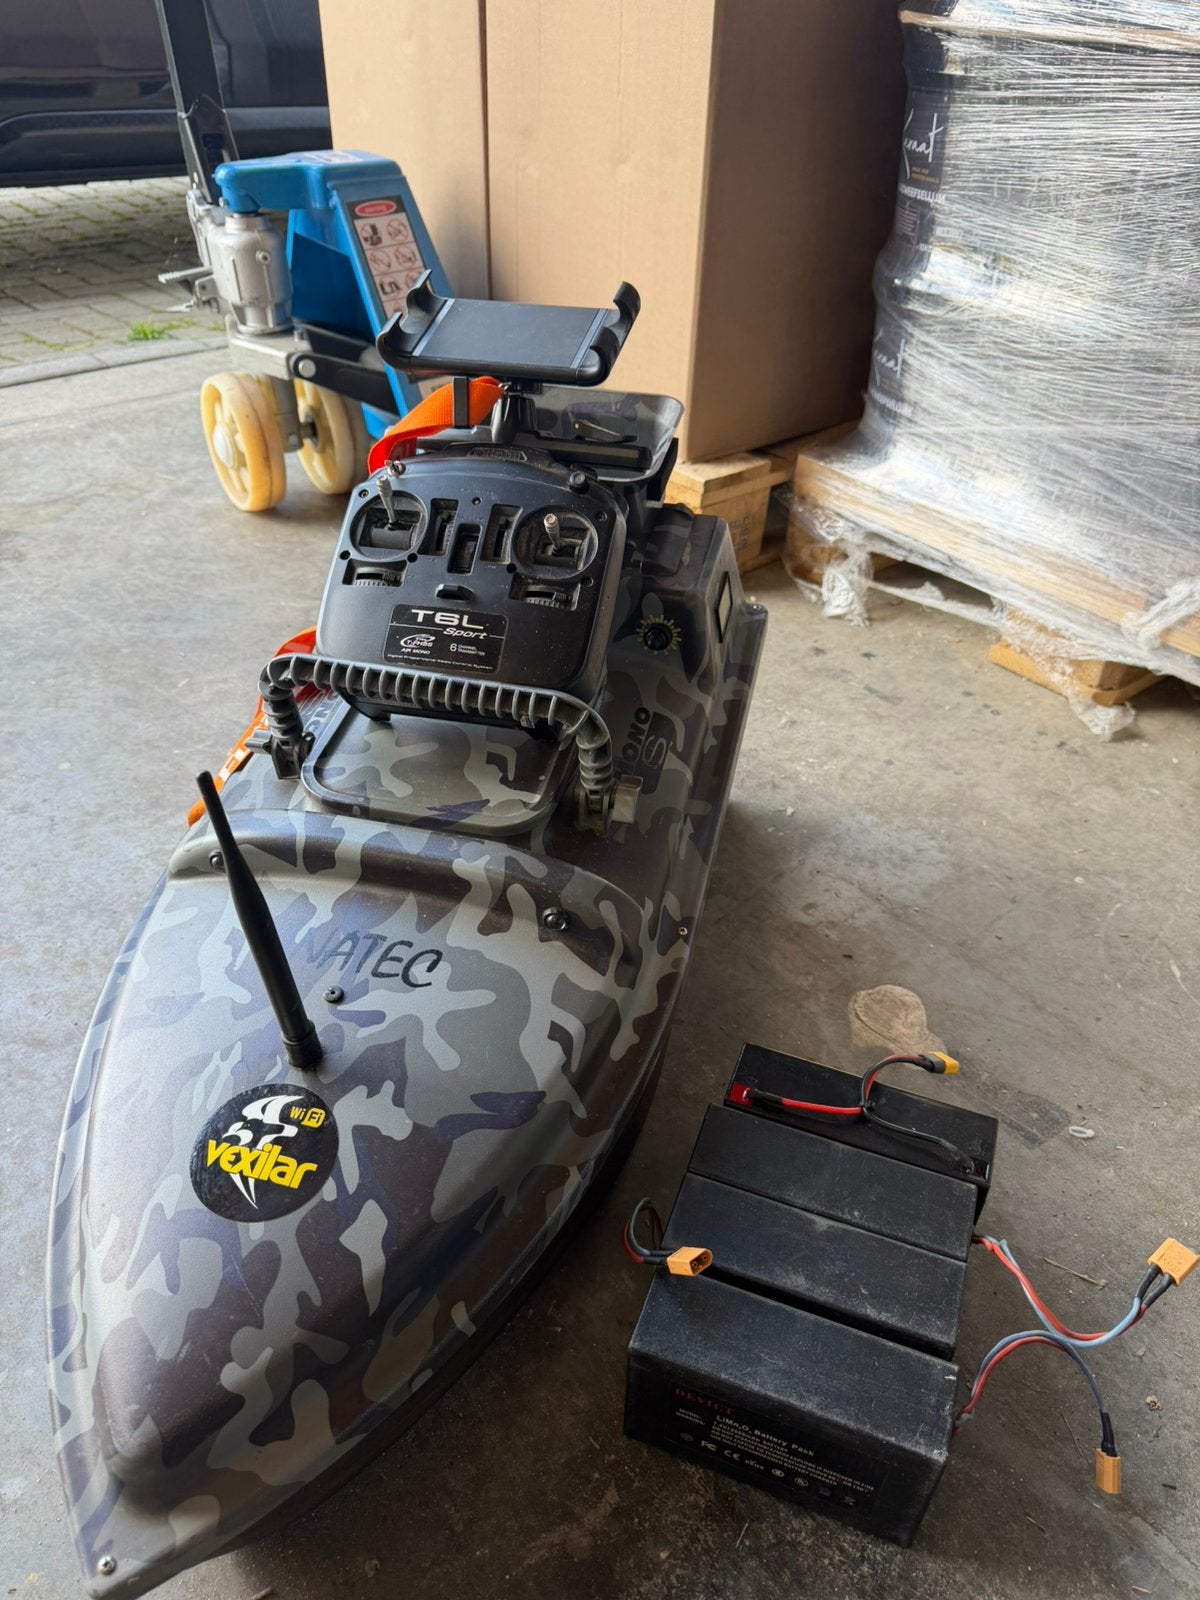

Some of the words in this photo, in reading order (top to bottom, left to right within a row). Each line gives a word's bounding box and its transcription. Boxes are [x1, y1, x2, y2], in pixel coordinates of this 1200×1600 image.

[411, 609, 483, 629] T6L
[443, 627, 488, 640] Sport
[449, 642, 457, 652] 6
[754, 1427, 787, 1447] Battery
[791, 1442, 814, 1457] Pack
